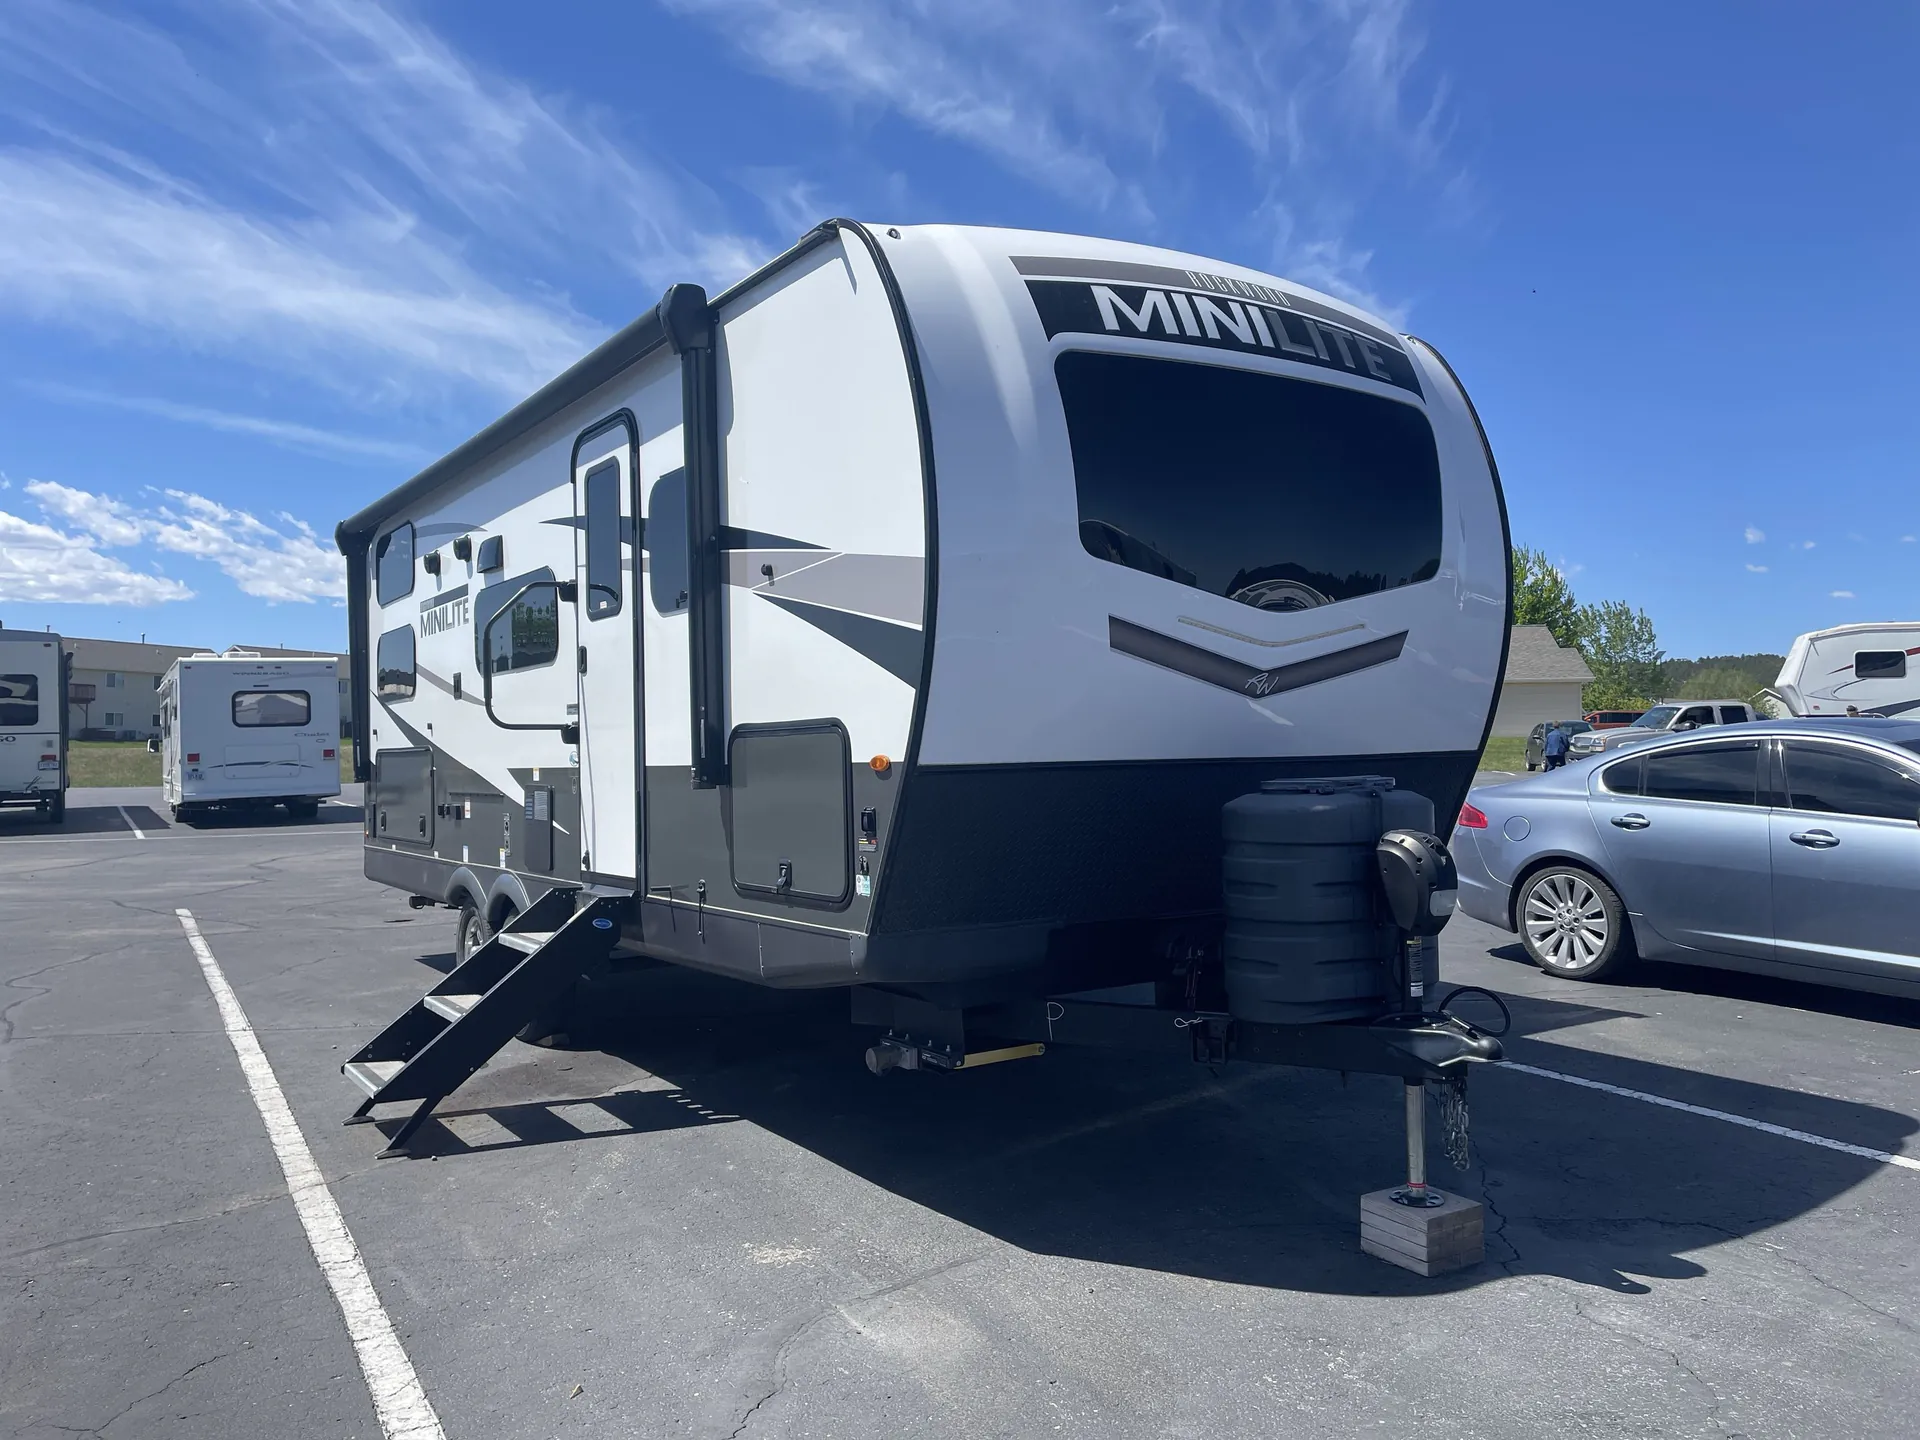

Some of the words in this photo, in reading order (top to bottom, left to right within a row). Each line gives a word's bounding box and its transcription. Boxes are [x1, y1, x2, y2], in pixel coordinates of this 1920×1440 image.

[1184, 269, 1292, 307] ROCKWOOD
[1089, 284, 1393, 381] MINILITE
[420, 597, 469, 639] MINILITE
[1244, 672, 1279, 695] RW
